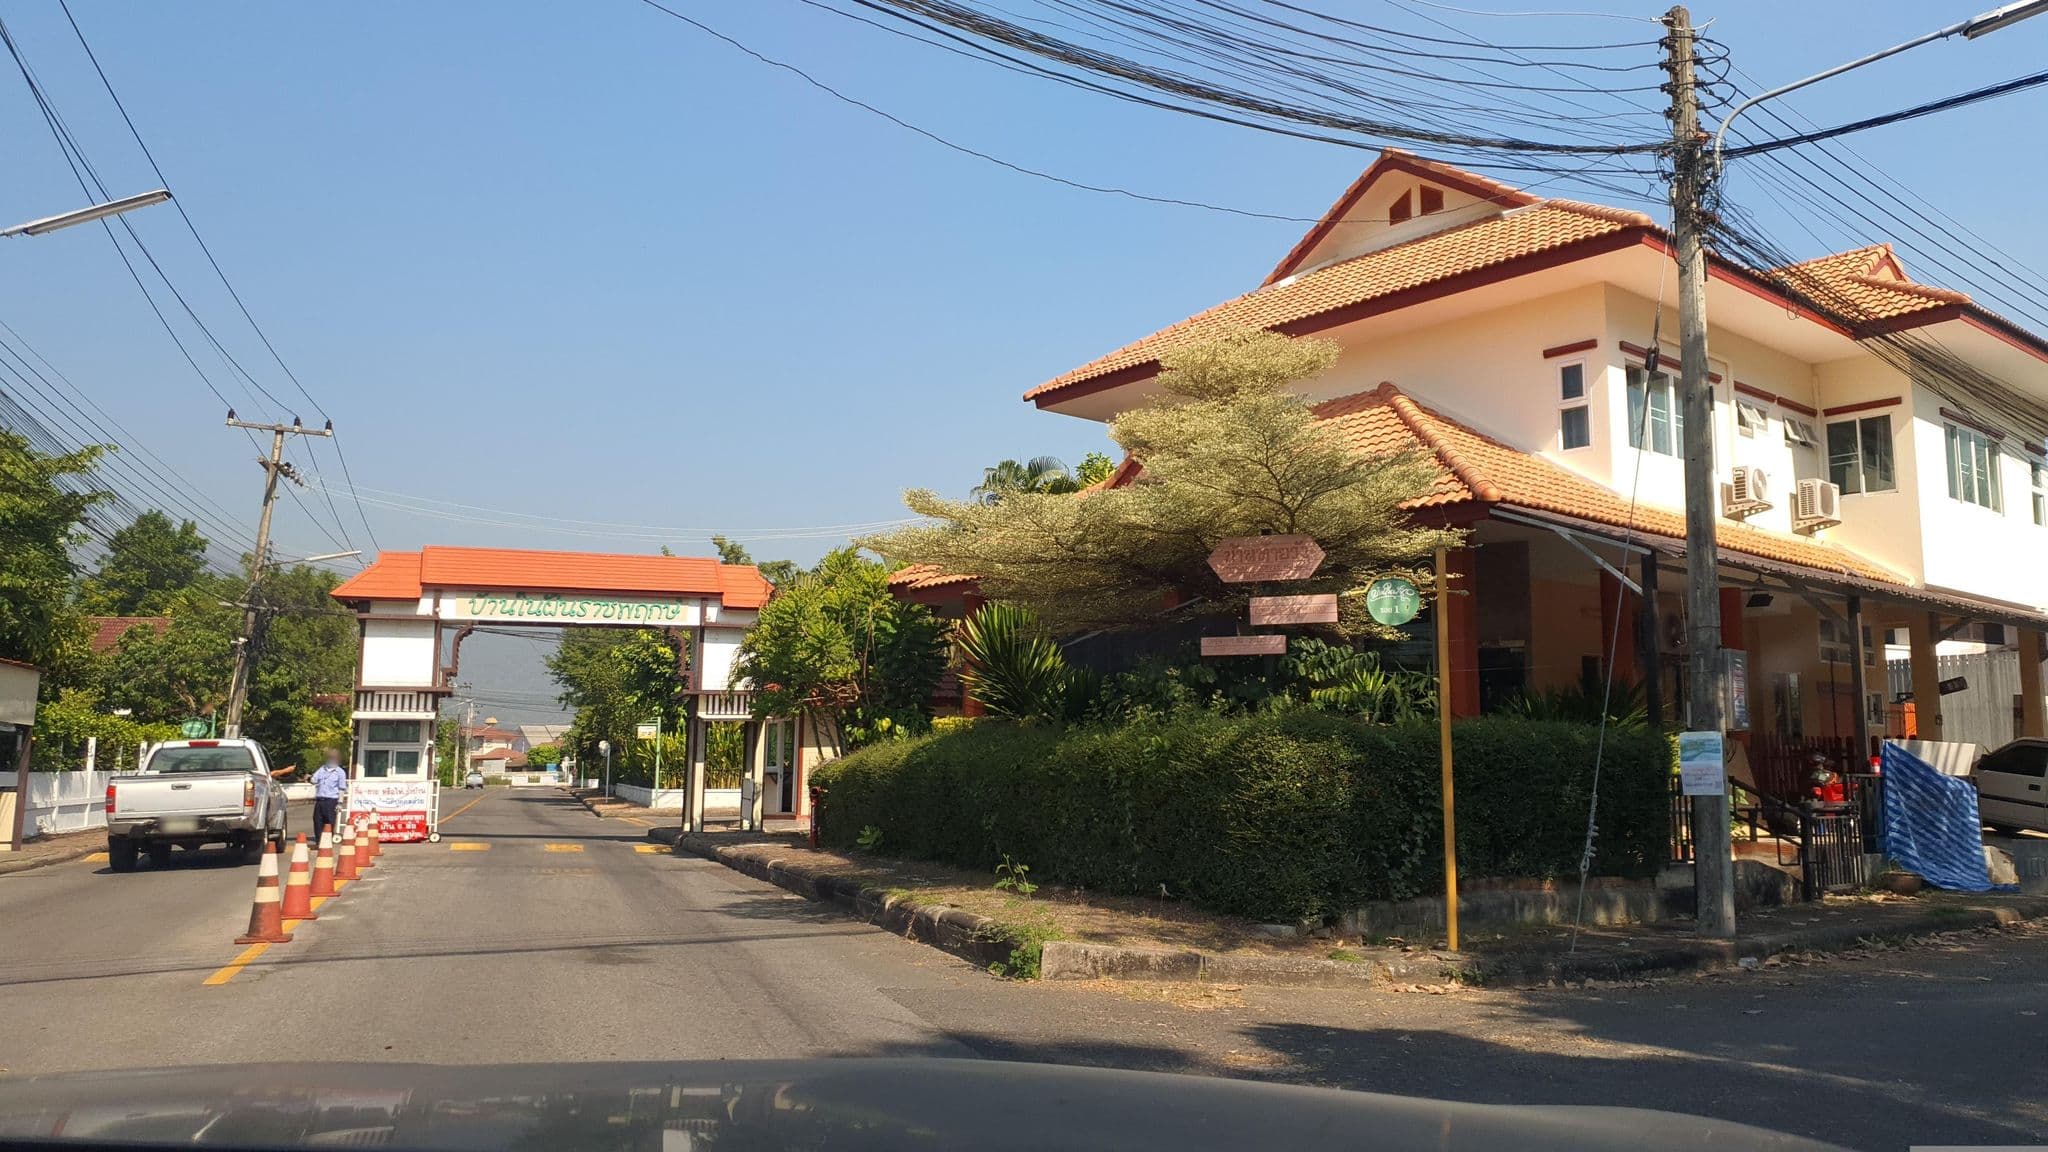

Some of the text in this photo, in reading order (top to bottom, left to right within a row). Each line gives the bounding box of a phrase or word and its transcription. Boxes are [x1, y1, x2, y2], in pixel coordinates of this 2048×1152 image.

[469, 591, 681, 624] บ้านในฝันราชพฤกษ์
